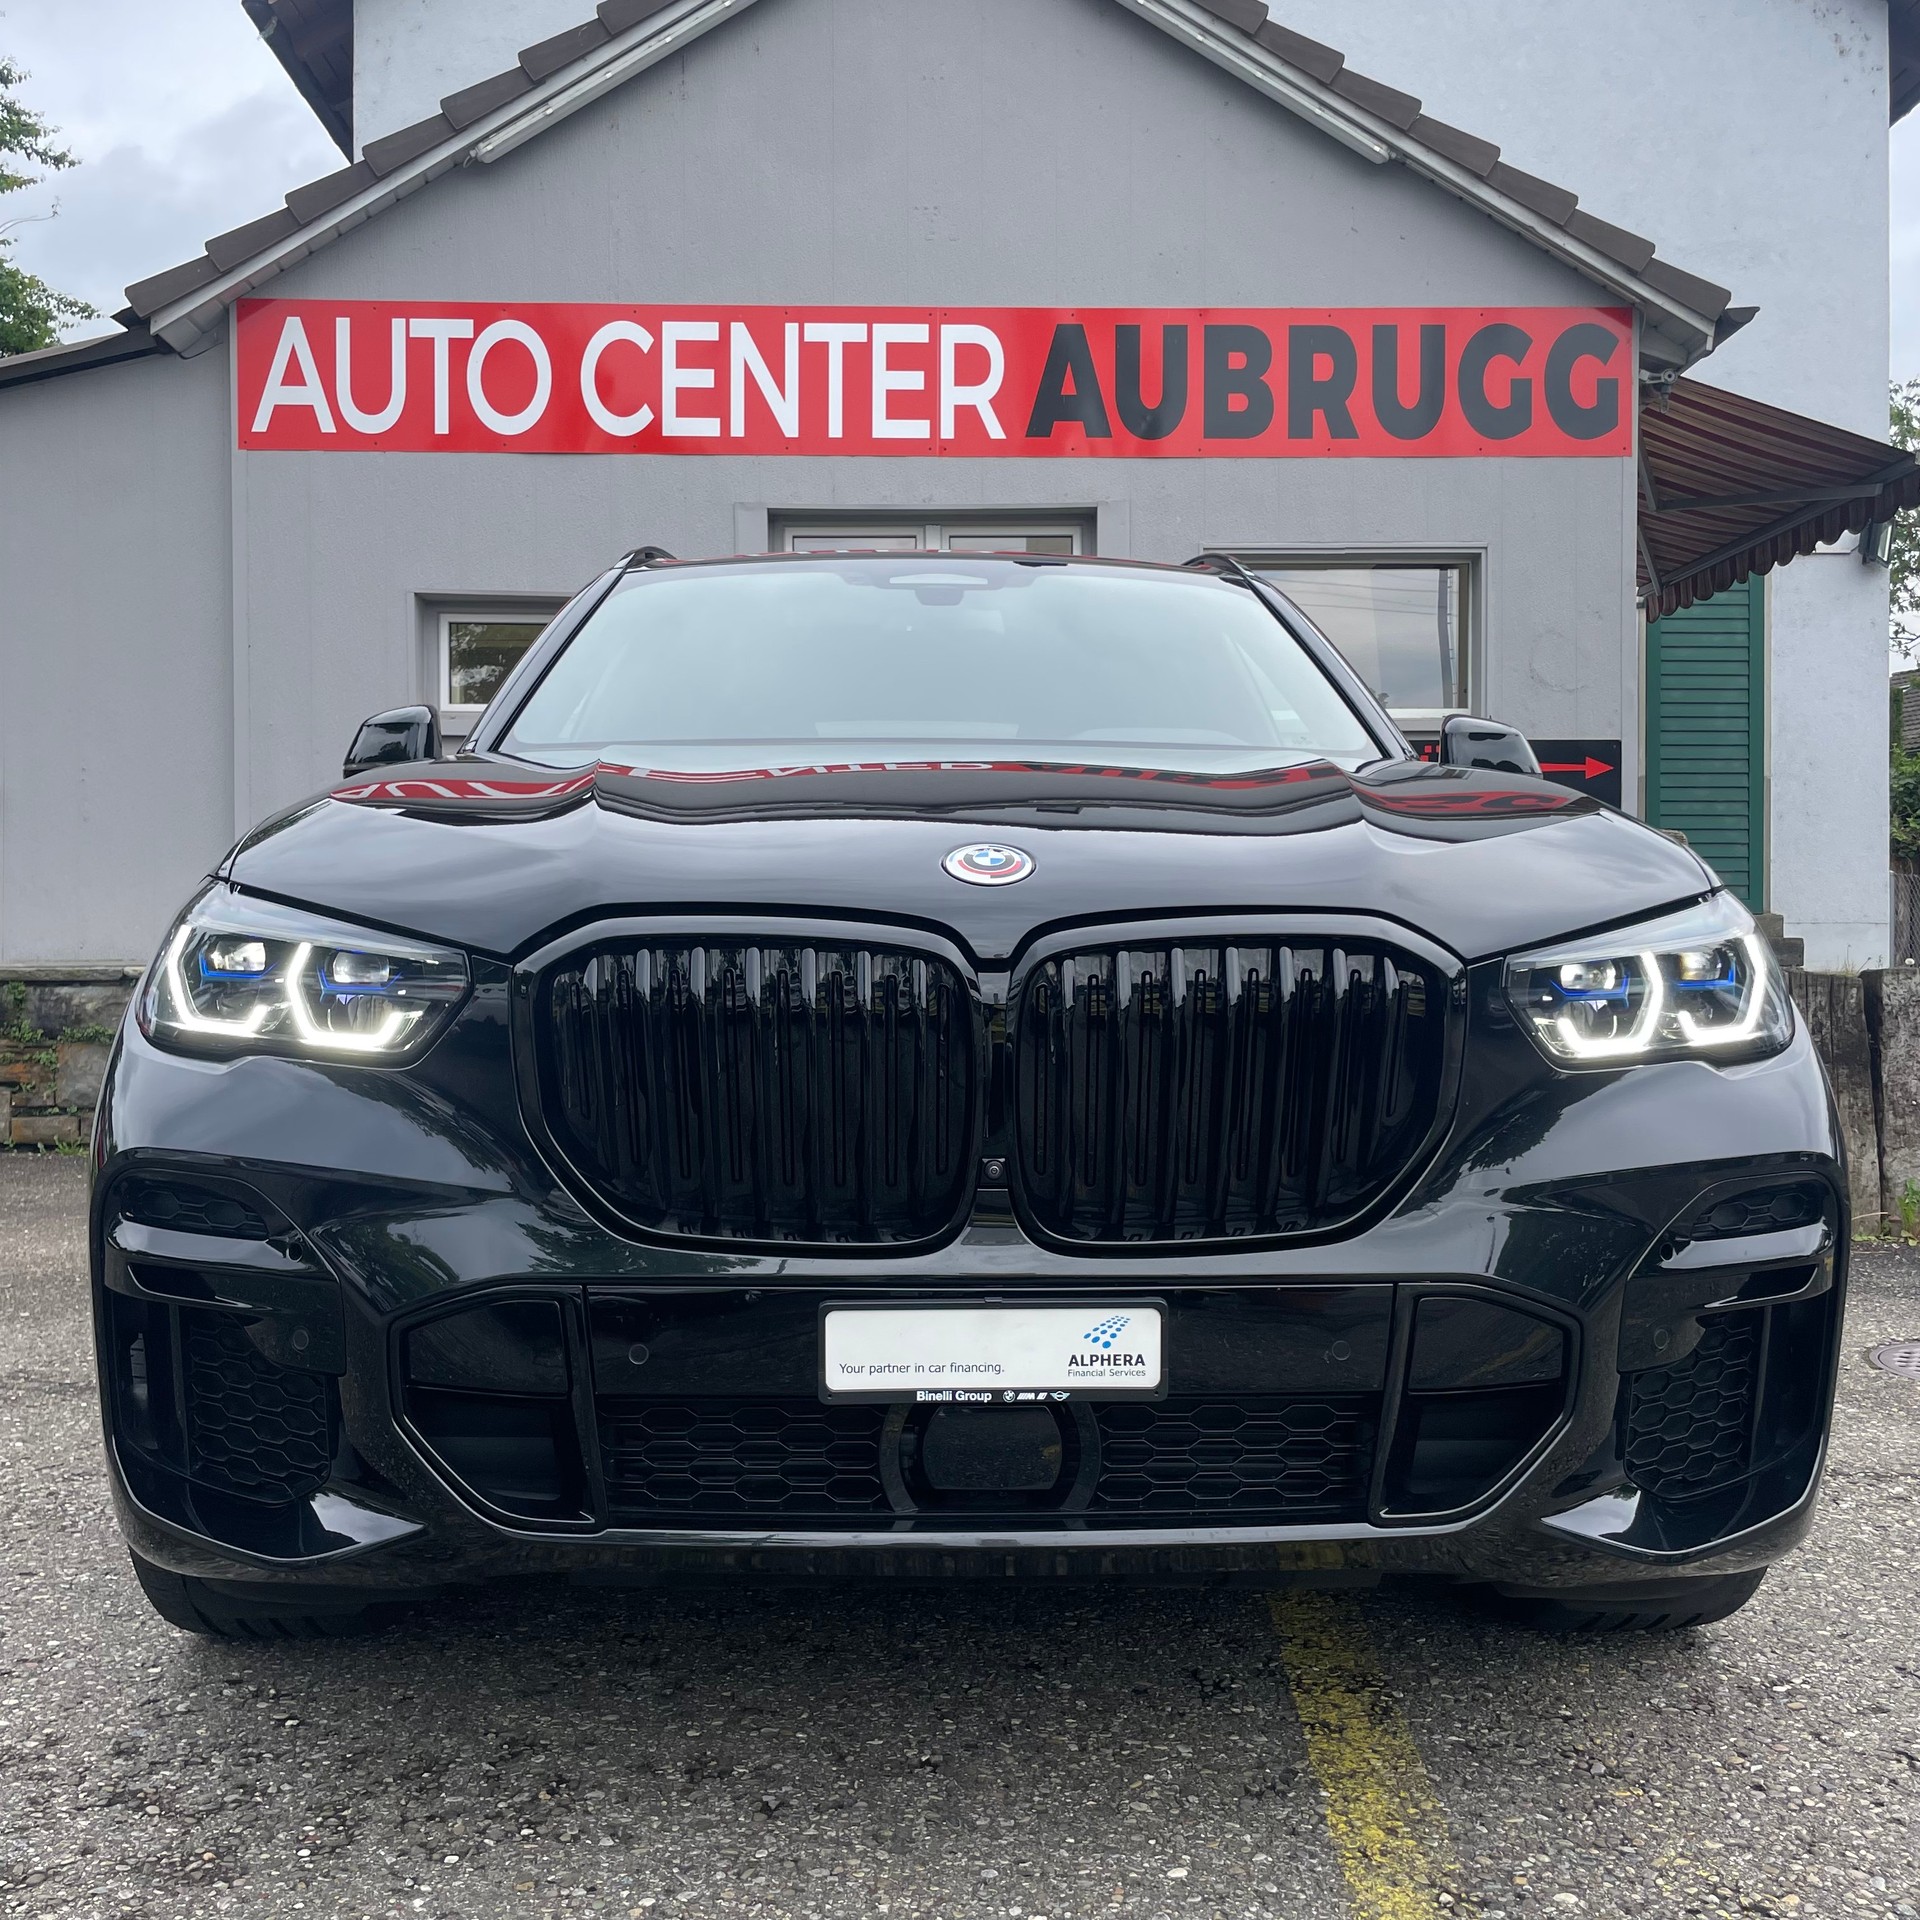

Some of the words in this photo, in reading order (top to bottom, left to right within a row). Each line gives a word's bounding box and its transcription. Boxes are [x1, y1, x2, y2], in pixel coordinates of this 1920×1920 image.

[252, 316, 552, 436] AUTO
[580, 320, 1006, 440] CENTER
[1025, 323, 1619, 441] AUBRUGG
[1067, 1353, 1146, 1367] ALPHERA
[839, 1363, 865, 1374] Your
[869, 1363, 910, 1376] partner
[914, 1362, 925, 1373] in
[928, 1364, 946, 1373] car
[950, 1362, 1005, 1375] financing.
[1067, 1368, 1106, 1377] Financial
[1109, 1368, 1146, 1377] Services
[916, 1390, 952, 1401] Binelli
[955, 1390, 992, 1403] Group
